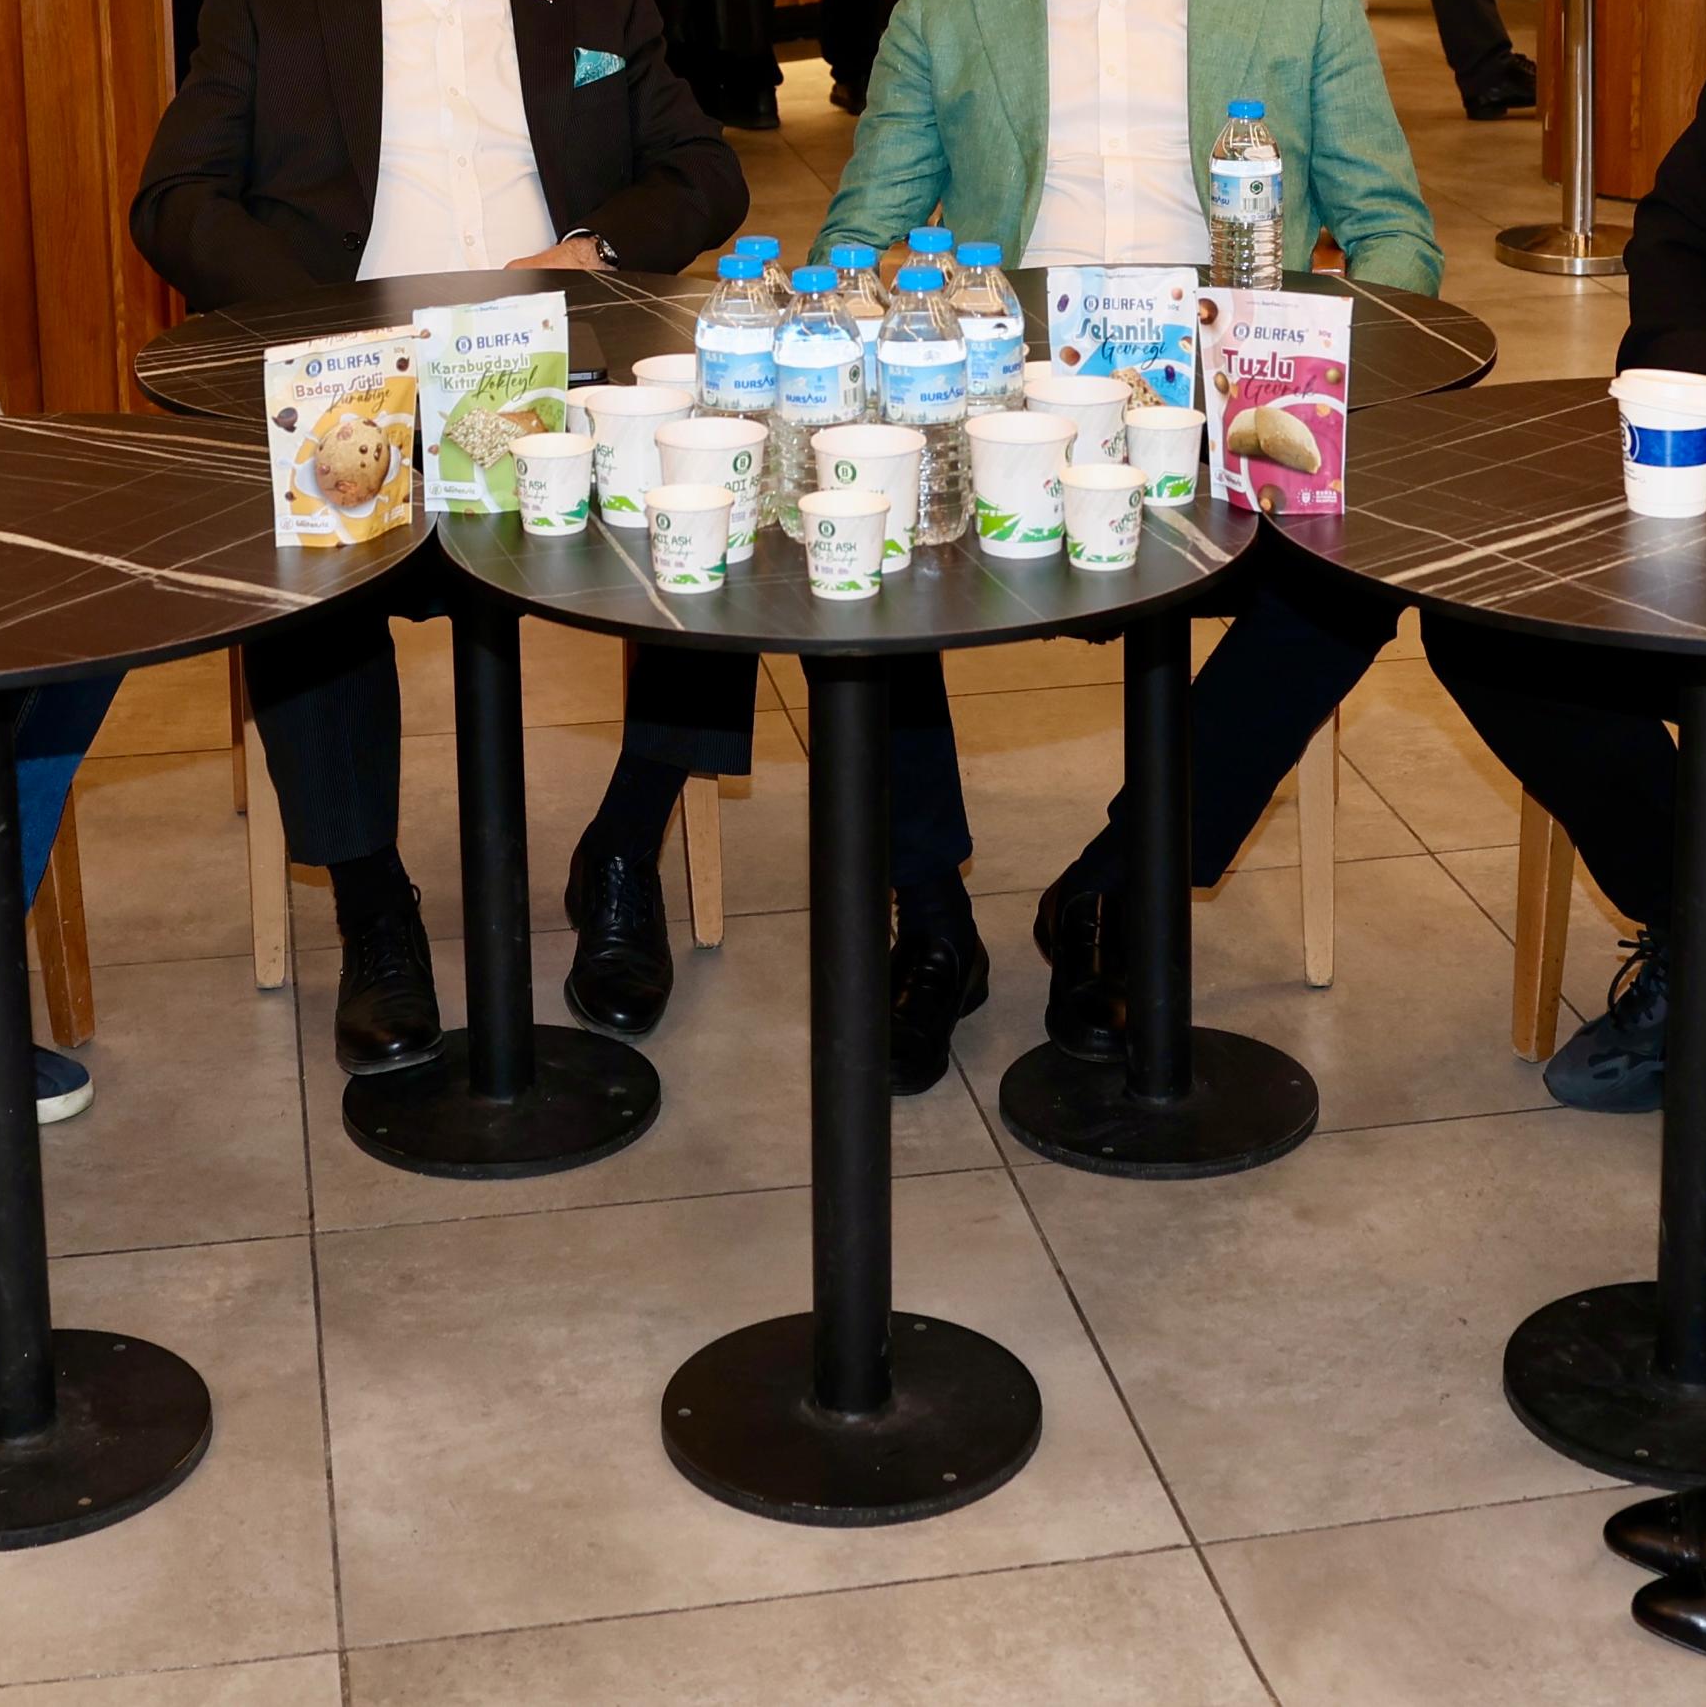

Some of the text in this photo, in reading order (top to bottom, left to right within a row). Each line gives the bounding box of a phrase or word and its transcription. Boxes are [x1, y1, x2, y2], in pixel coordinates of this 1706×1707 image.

[1103, 297, 1154, 312] BURFAŞ
[1075, 316, 1161, 341] Selanik
[1254, 326, 1305, 345] BURFAŞ
[476, 331, 530, 349] BURFAŞ
[326, 352, 381, 372] BURFAŞ
[431, 352, 529, 375] Karabuğdaylı
[1222, 348, 1293, 380] Tuzlu
[295, 372, 383, 398] Badem Sütlü
[734, 376, 775, 389] BURSAS
